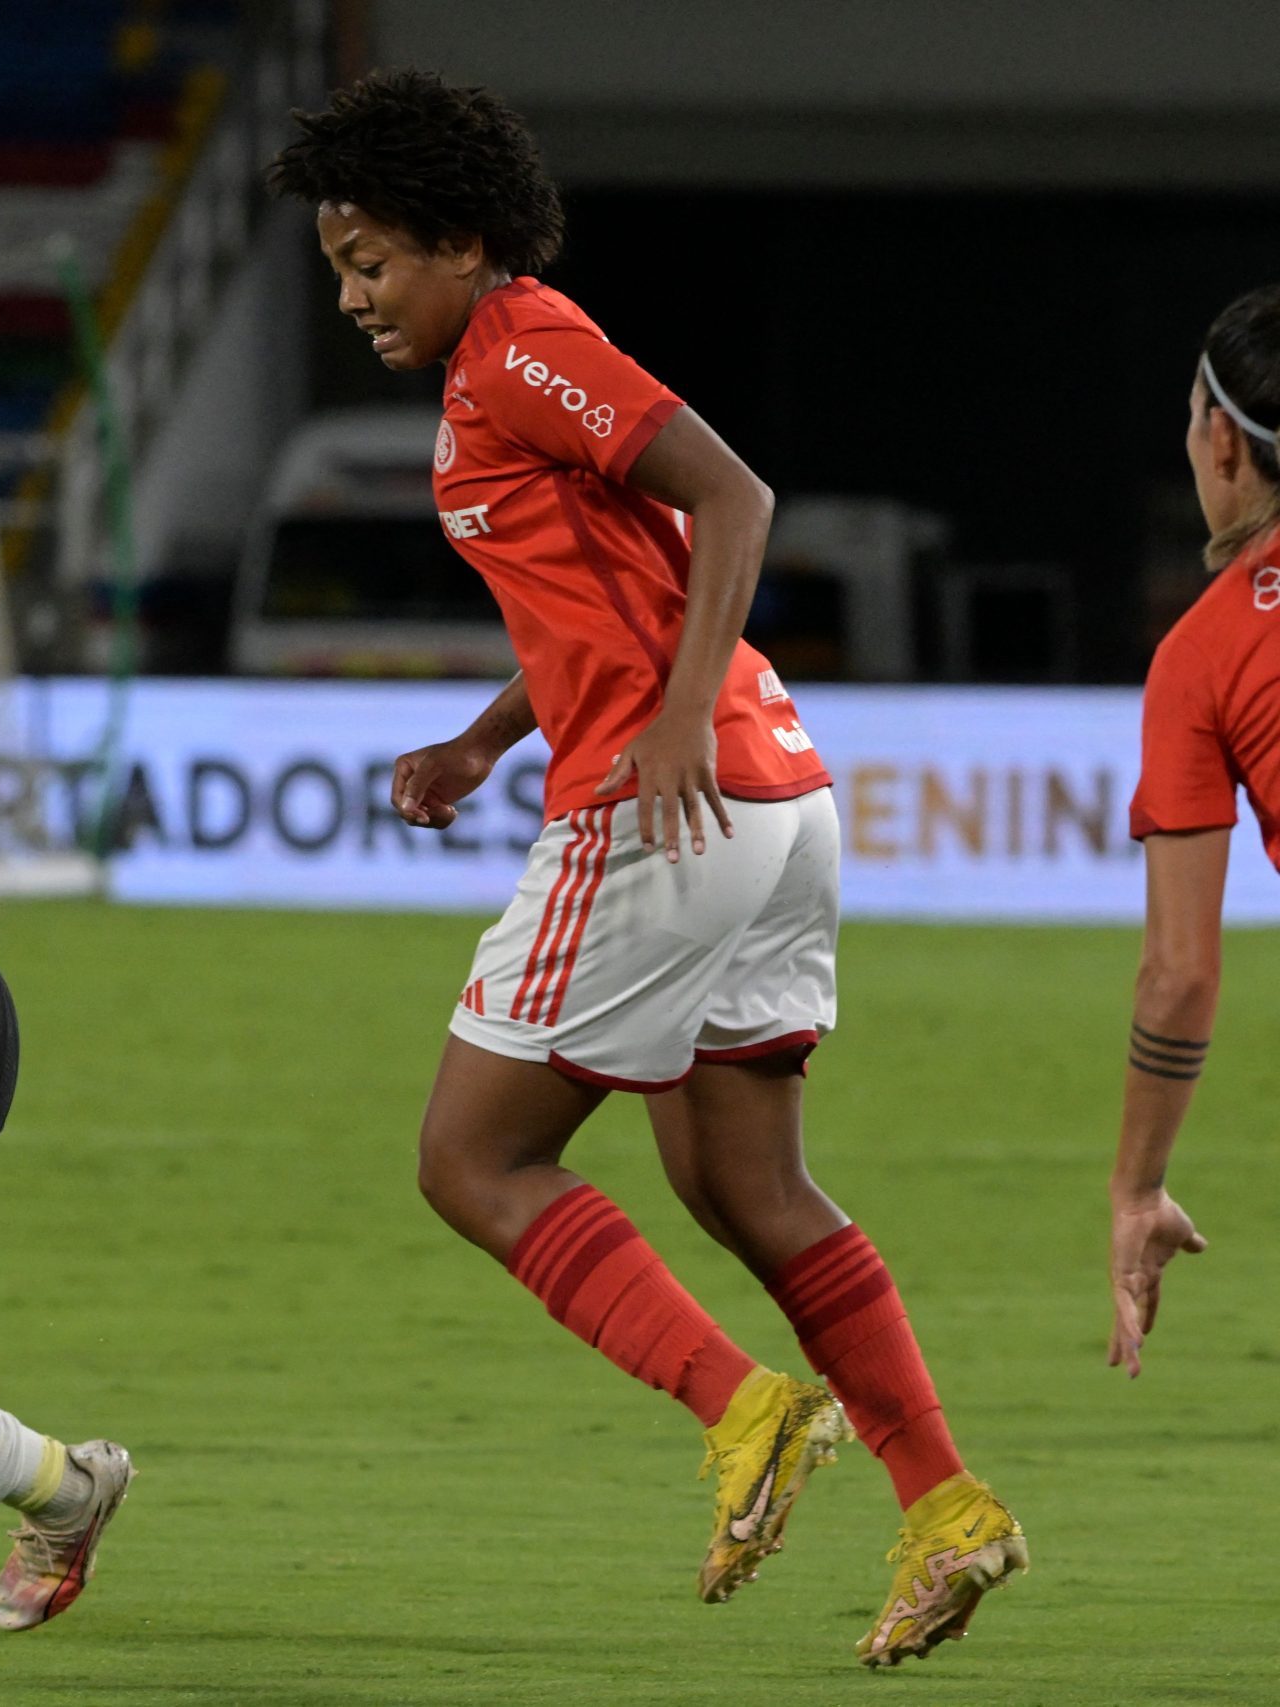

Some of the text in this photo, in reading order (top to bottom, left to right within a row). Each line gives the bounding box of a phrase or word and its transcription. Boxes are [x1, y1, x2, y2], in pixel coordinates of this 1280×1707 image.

[504, 344, 587, 412] vero
[438, 503, 492, 540] BET
[772, 720, 815, 754] Uni
[848, 765, 1140, 857] ENIN
